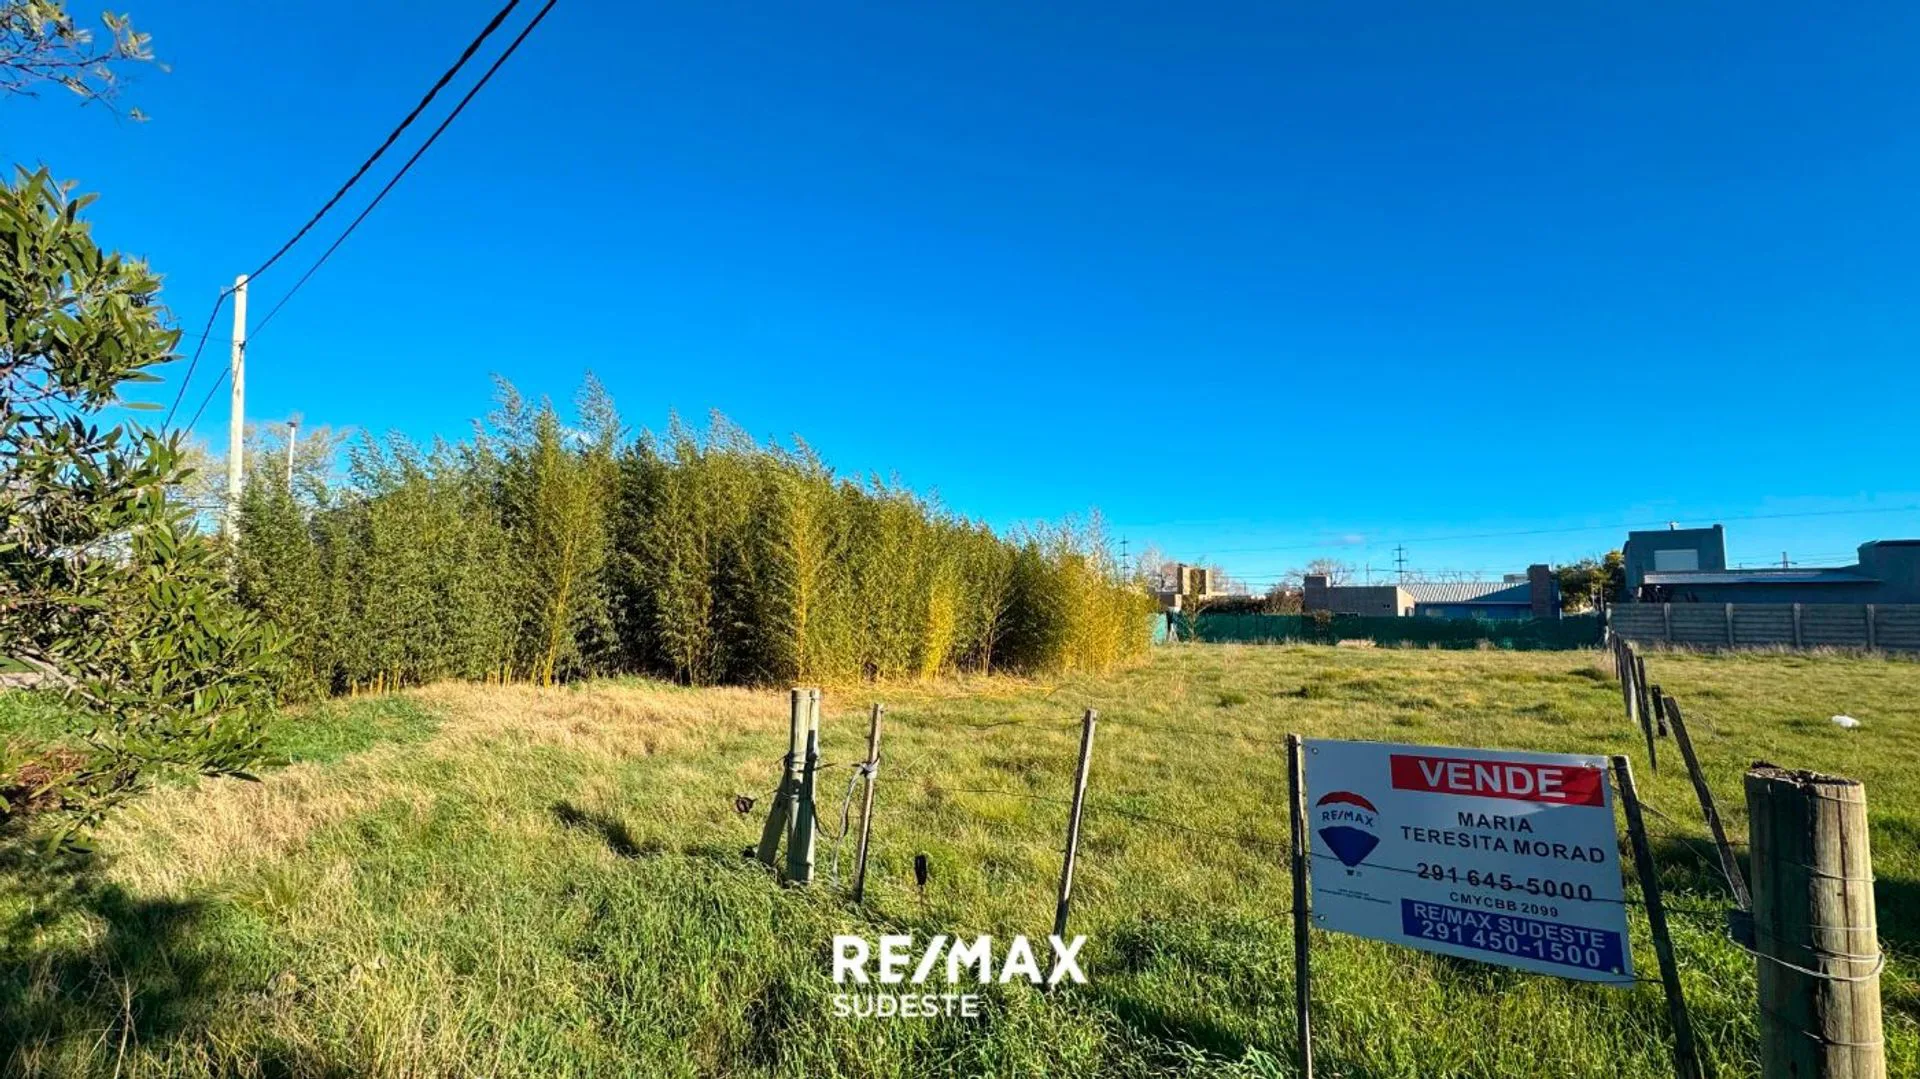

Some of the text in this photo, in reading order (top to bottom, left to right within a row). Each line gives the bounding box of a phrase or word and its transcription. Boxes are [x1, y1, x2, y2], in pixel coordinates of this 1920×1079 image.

[1418, 759, 1566, 798] VENDE
[1321, 810, 1374, 827] RE/MAX
[1458, 812, 1533, 833] MARIA
[1400, 825, 1605, 864] TERESITA MORAD
[1416, 862, 1593, 901] 291 645-5000
[1449, 891, 1559, 918] CMYCBB 2099
[1413, 903, 1606, 949] RE/MAX SUDESTE
[1422, 920, 1601, 968] 291 450-1500
